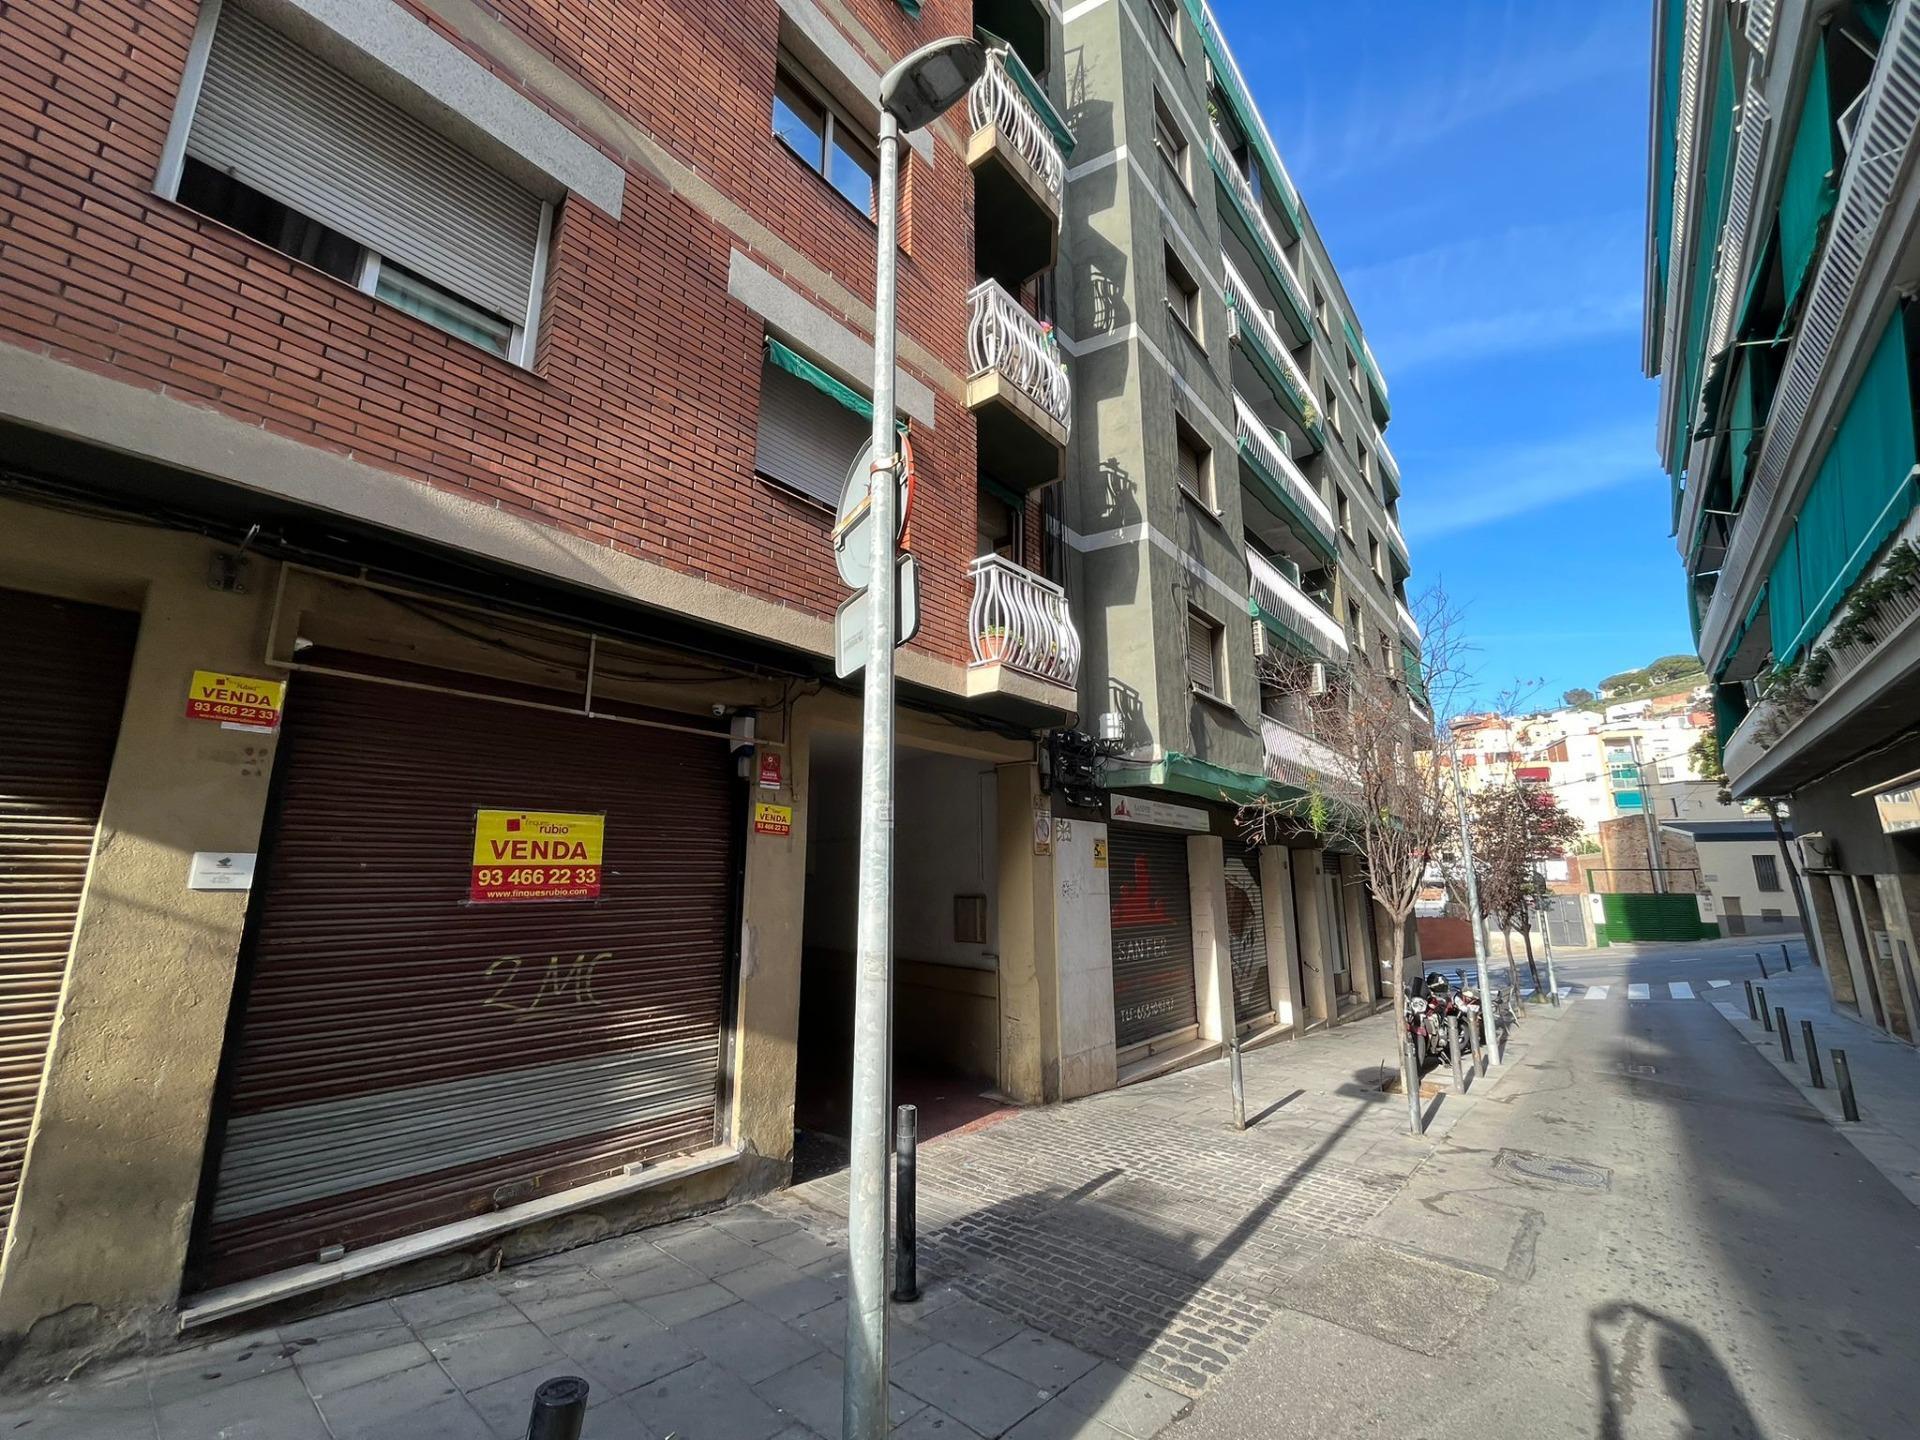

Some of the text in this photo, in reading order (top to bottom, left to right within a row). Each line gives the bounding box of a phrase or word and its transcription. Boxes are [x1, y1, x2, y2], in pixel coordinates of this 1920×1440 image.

[203, 687, 271, 706] VENDA
[194, 702, 274, 719] 93 466 22 33
[760, 813, 787, 823] VENDA
[539, 824, 569, 834] rubio
[490, 840, 588, 860] VENDA
[478, 868, 597, 886] 93 466 22 33
[487, 888, 588, 898] www.finquesrubio.com
